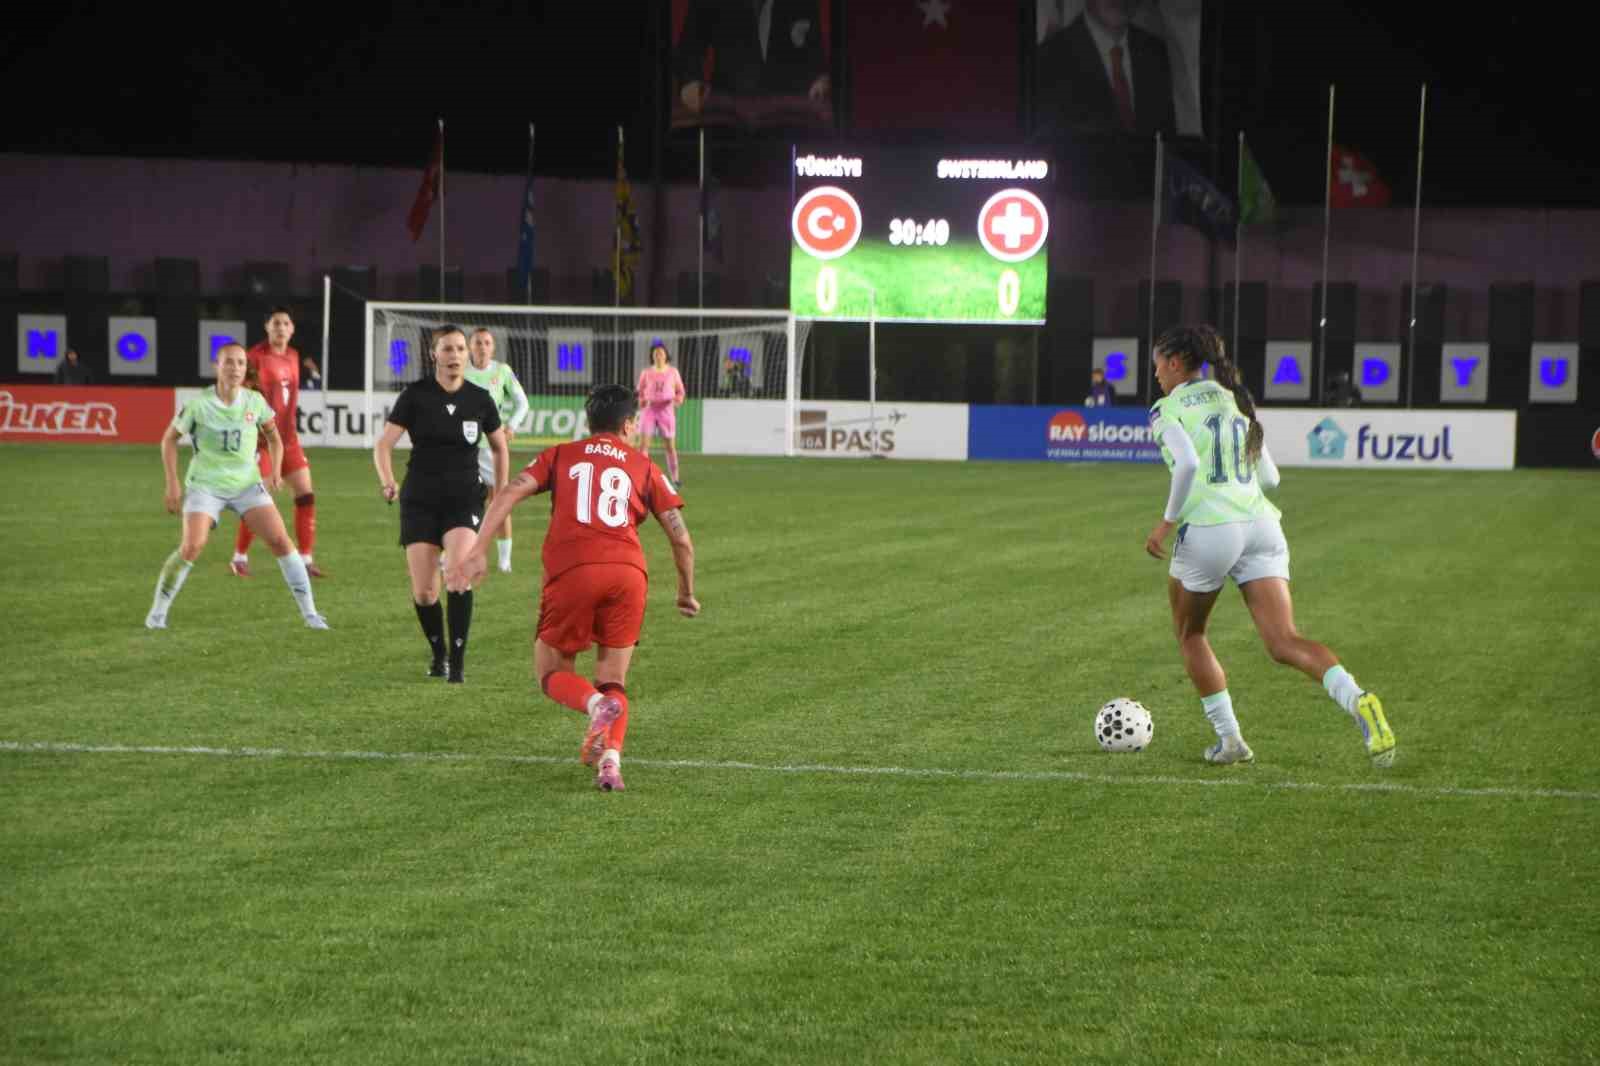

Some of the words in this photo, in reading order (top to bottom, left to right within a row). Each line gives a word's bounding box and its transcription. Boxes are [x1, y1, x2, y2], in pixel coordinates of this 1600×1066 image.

[816, 268, 837, 312] 0
[998, 271, 1019, 315] 0
[220, 430, 241, 452] 13
[831, 429, 896, 451] PASS
[1048, 423, 1087, 441] RAY
[1088, 420, 1155, 443] SİGORT
[1203, 413, 1253, 484] 10
[1356, 424, 1453, 461] fuzul
[568, 461, 632, 528] 18
